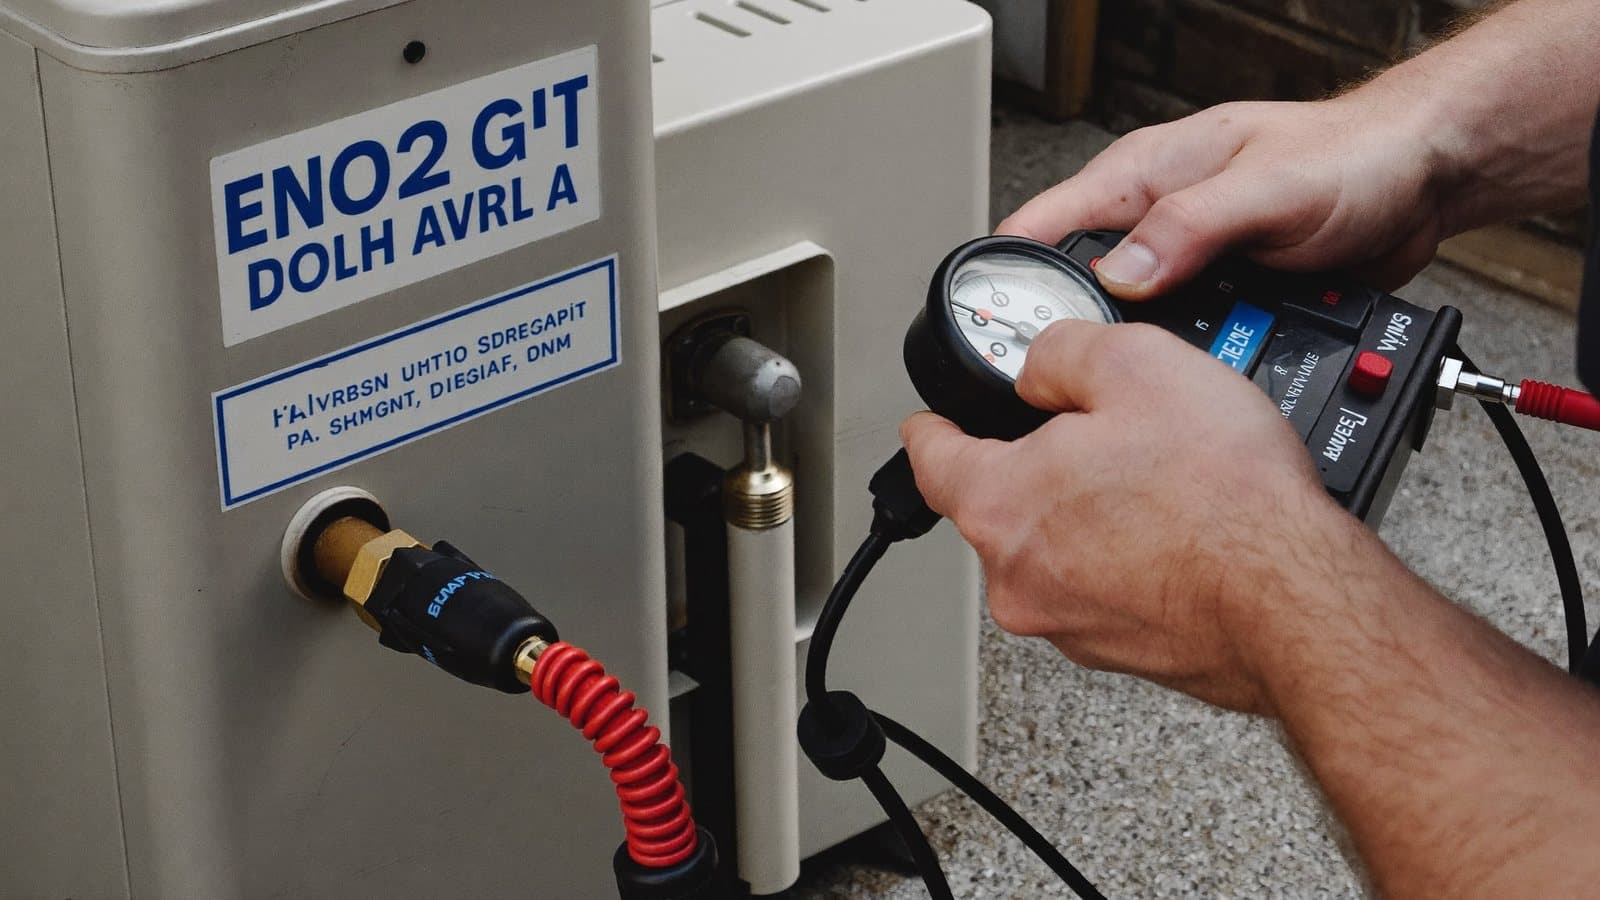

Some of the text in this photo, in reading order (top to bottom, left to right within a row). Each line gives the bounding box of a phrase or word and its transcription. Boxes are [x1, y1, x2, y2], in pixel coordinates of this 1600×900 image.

[223, 119, 451, 256] ENO2
[247, 162, 578, 312] DOLH AVRL A
[526, 333, 572, 364] DNM
